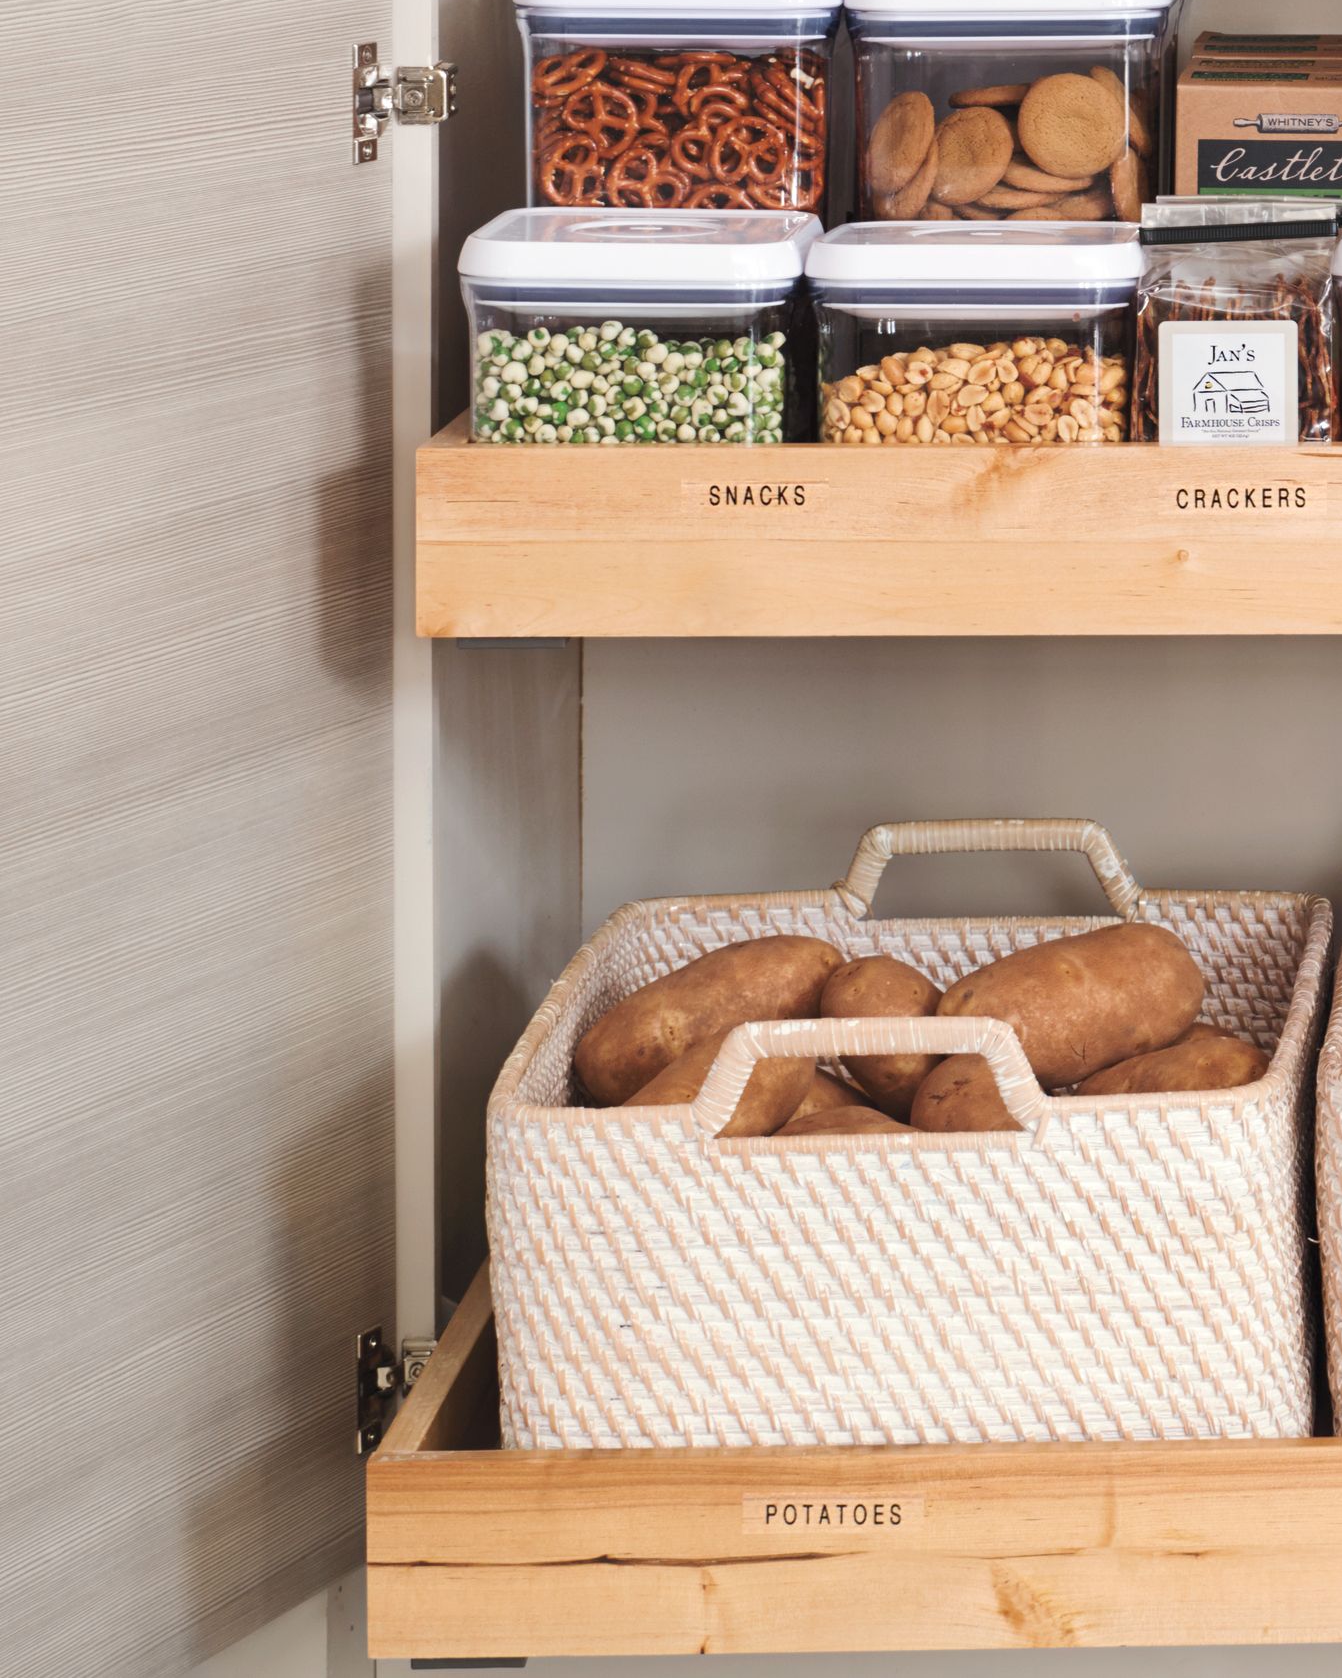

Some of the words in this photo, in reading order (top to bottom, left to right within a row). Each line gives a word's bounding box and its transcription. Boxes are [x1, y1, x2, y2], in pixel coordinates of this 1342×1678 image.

[1268, 117, 1334, 127] WHITNEY'S
[1208, 343, 1256, 365] JAN'S
[709, 484, 806, 507] SNACKS
[1175, 487, 1306, 510] CRACKERS
[765, 1503, 902, 1526] POTATOES
